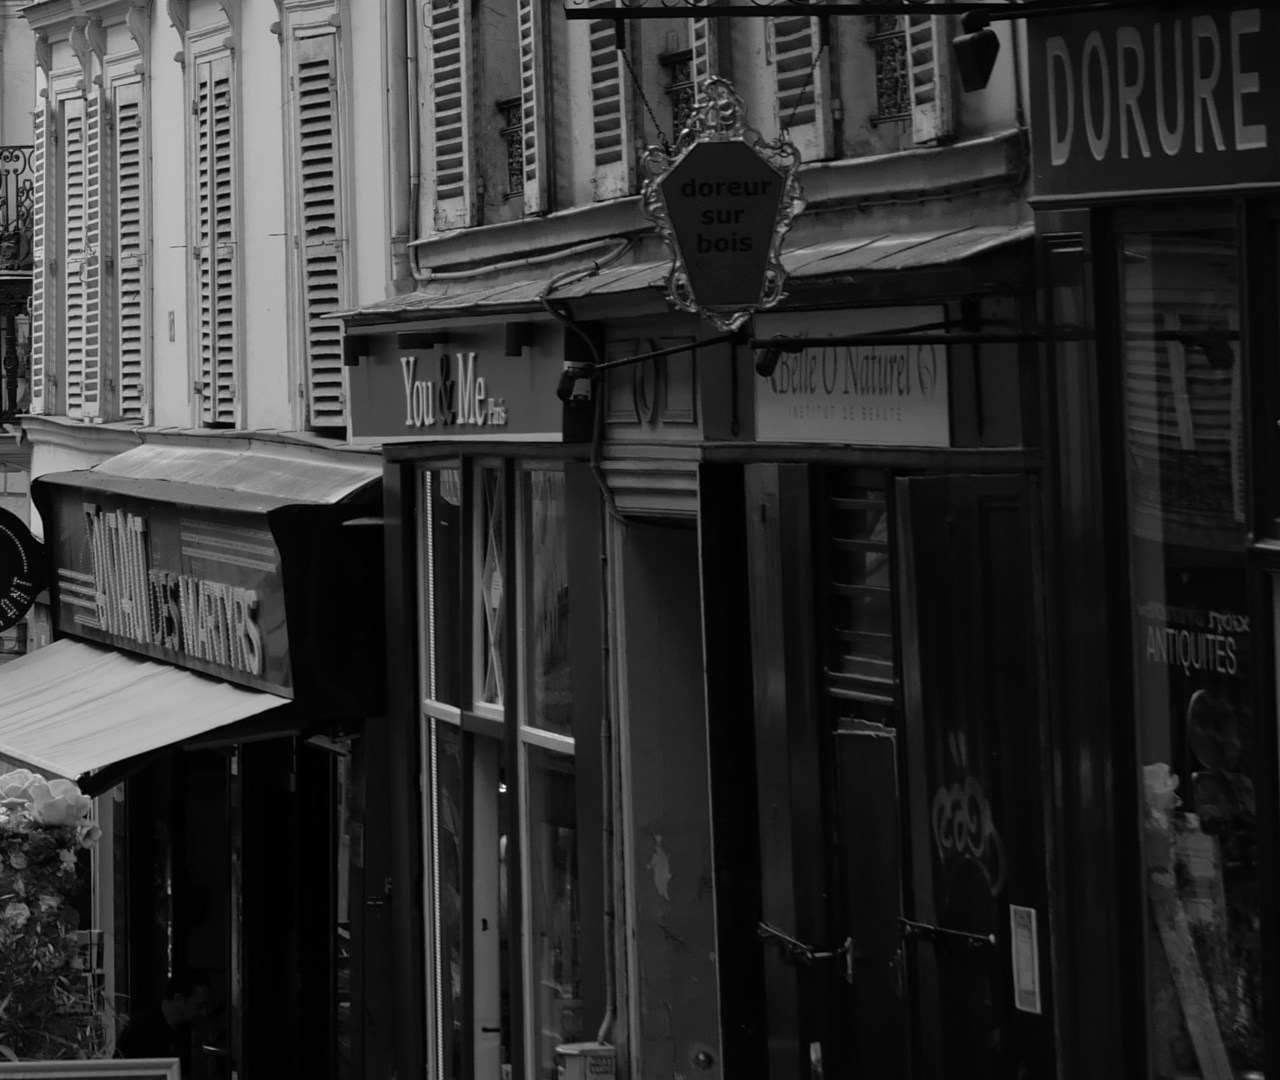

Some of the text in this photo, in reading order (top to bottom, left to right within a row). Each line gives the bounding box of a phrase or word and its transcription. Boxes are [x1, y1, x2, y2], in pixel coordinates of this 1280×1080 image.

[1046, 8, 1268, 167] DORURE
[681, 177, 772, 198] doreur
[701, 206, 745, 225] sur
[697, 232, 752, 253] bois
[400, 352, 507, 427] You & Me Paris
[179, 575, 262, 675] MARTYRS
